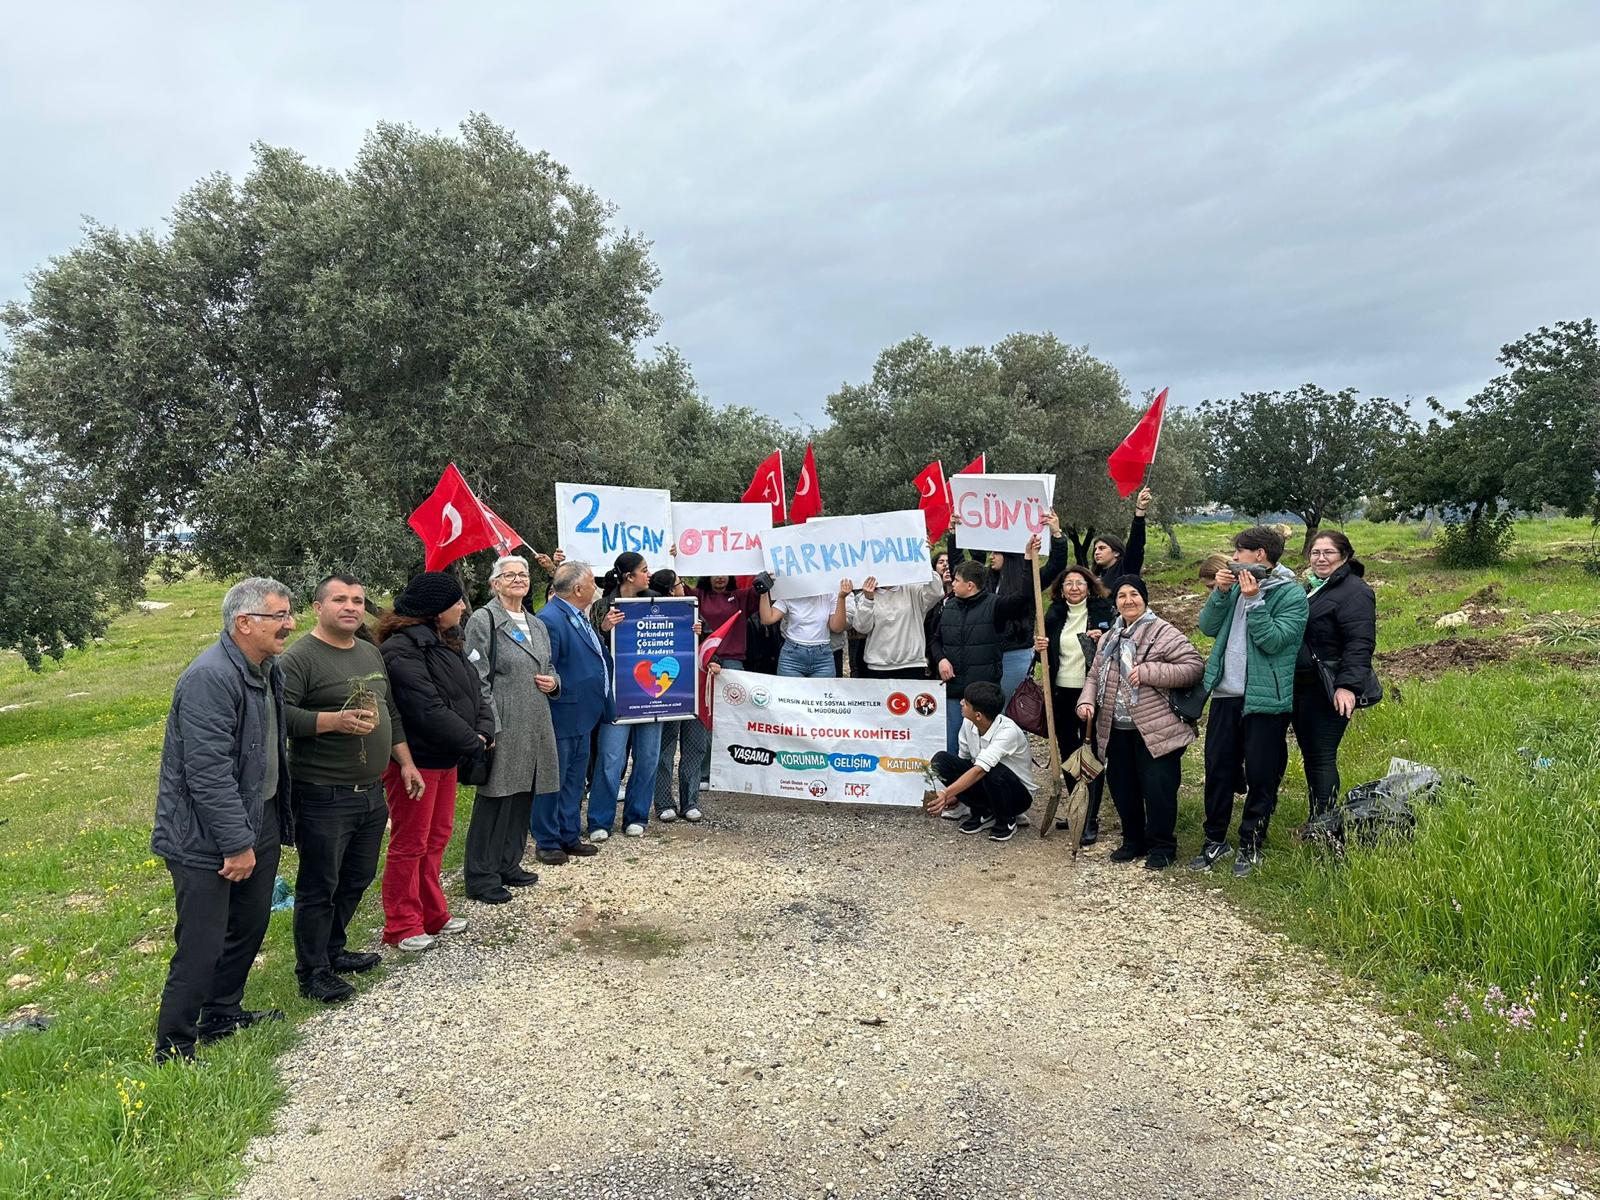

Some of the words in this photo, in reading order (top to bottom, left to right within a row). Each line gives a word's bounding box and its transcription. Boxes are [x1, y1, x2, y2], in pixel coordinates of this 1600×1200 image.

[572, 492, 600, 534] 2
[958, 491, 1044, 534] GÜNÜ
[601, 521, 664, 554] NİSAN
[679, 525, 763, 556] OTİZM
[637, 620, 674, 630] Otizmin
[637, 639, 674, 649] Çözümde
[778, 697, 800, 705] MERSİN
[814, 706, 851, 715] MÜDÜRLÜĞÜ
[747, 721, 793, 736] MERSİN
[796, 723, 808, 737] İL
[810, 727, 850, 740] ÇOCUK
[854, 727, 911, 741] KOMİTESİ
[734, 747, 770, 764] YAŞAMA
[780, 754, 826, 766] KORUNMA
[834, 755, 871, 770] GELİŞİM
[887, 760, 922, 771] KATILIM
